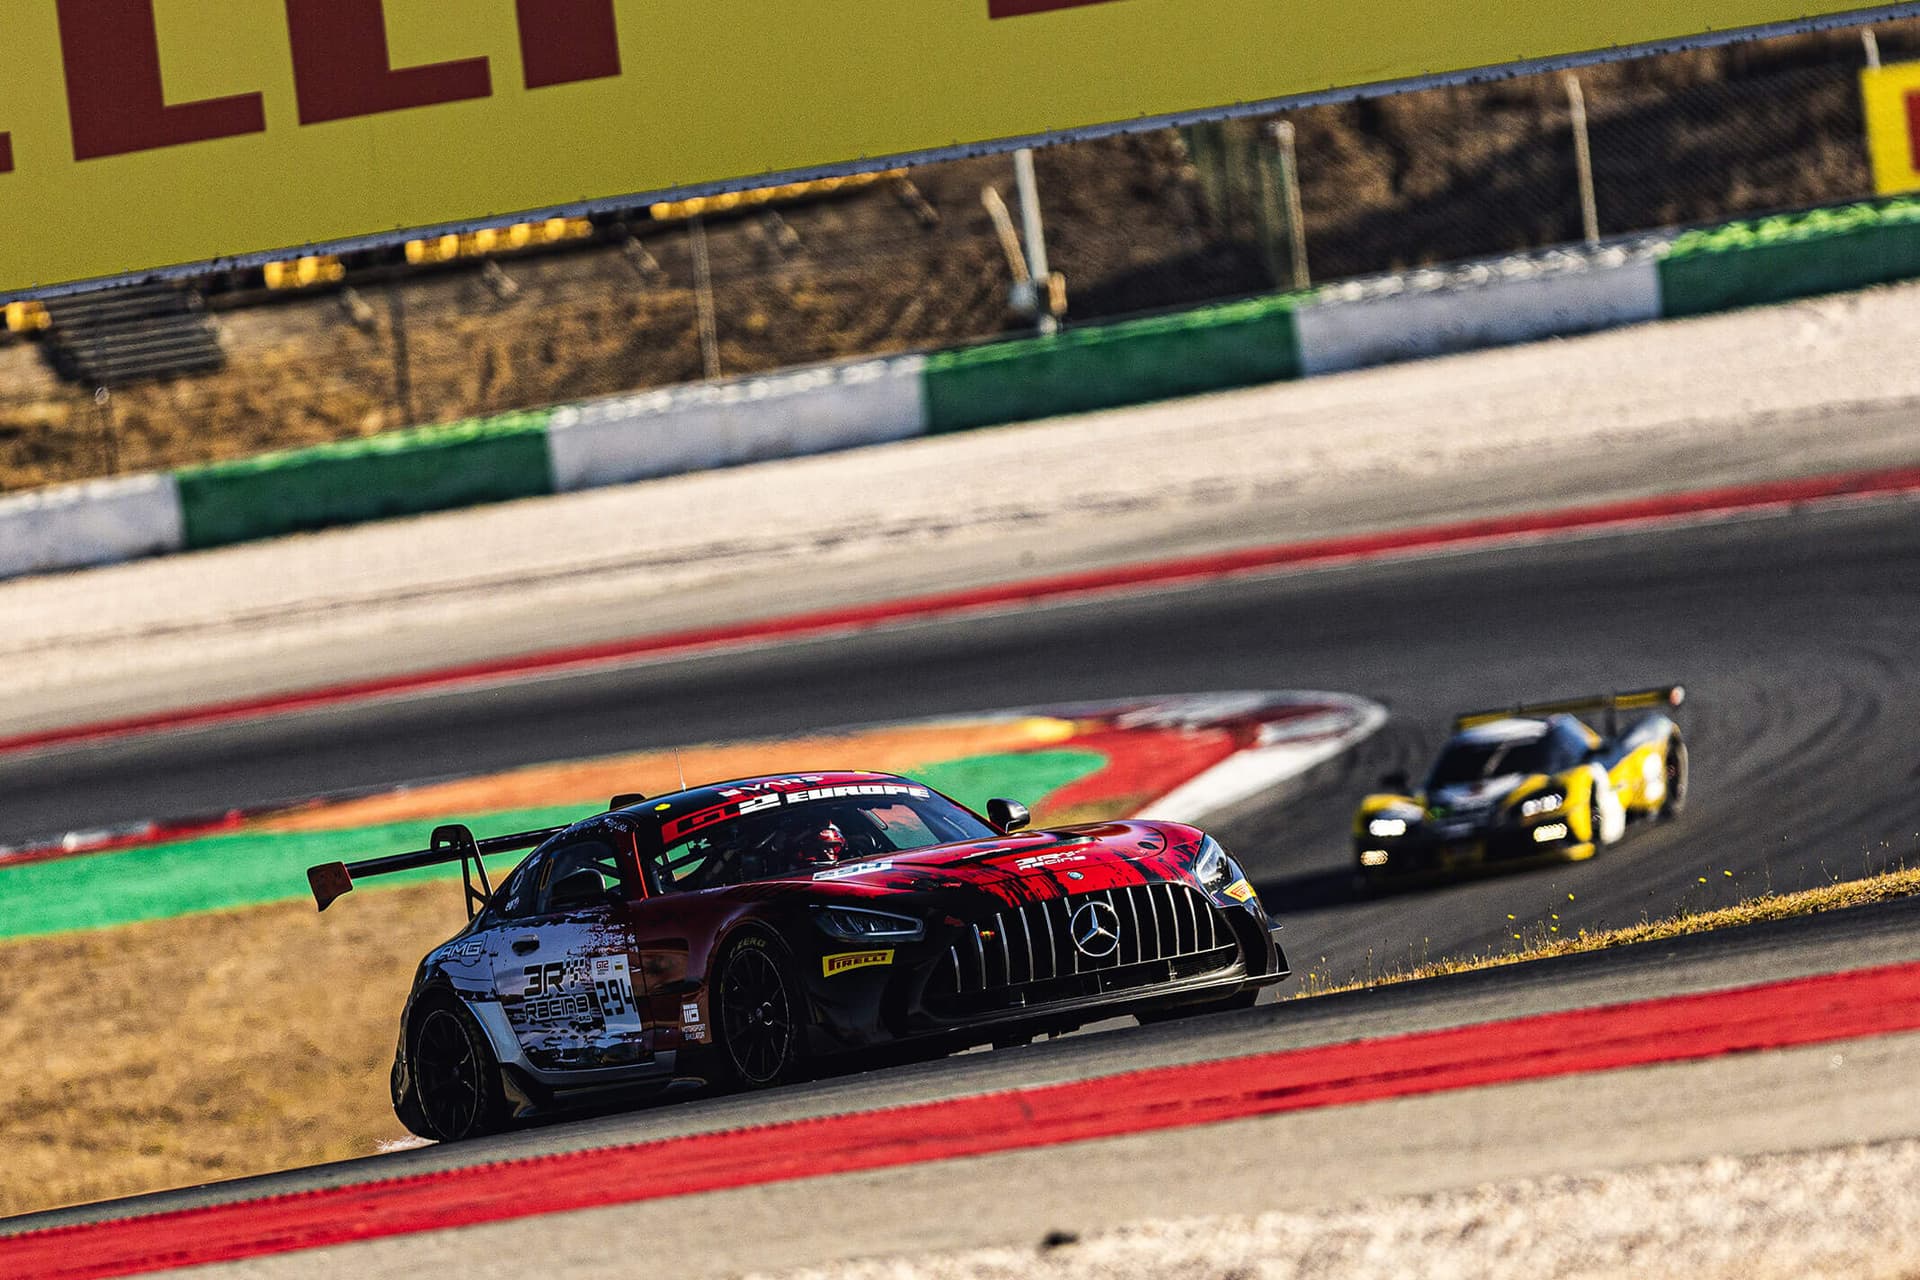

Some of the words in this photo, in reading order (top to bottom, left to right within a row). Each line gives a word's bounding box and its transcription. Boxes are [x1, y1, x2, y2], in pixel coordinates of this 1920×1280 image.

[786, 785, 930, 804] EUROPE
[440, 941, 482, 957] AMG
[828, 952, 888, 972] PIRELLI
[595, 977, 637, 1016] 294
